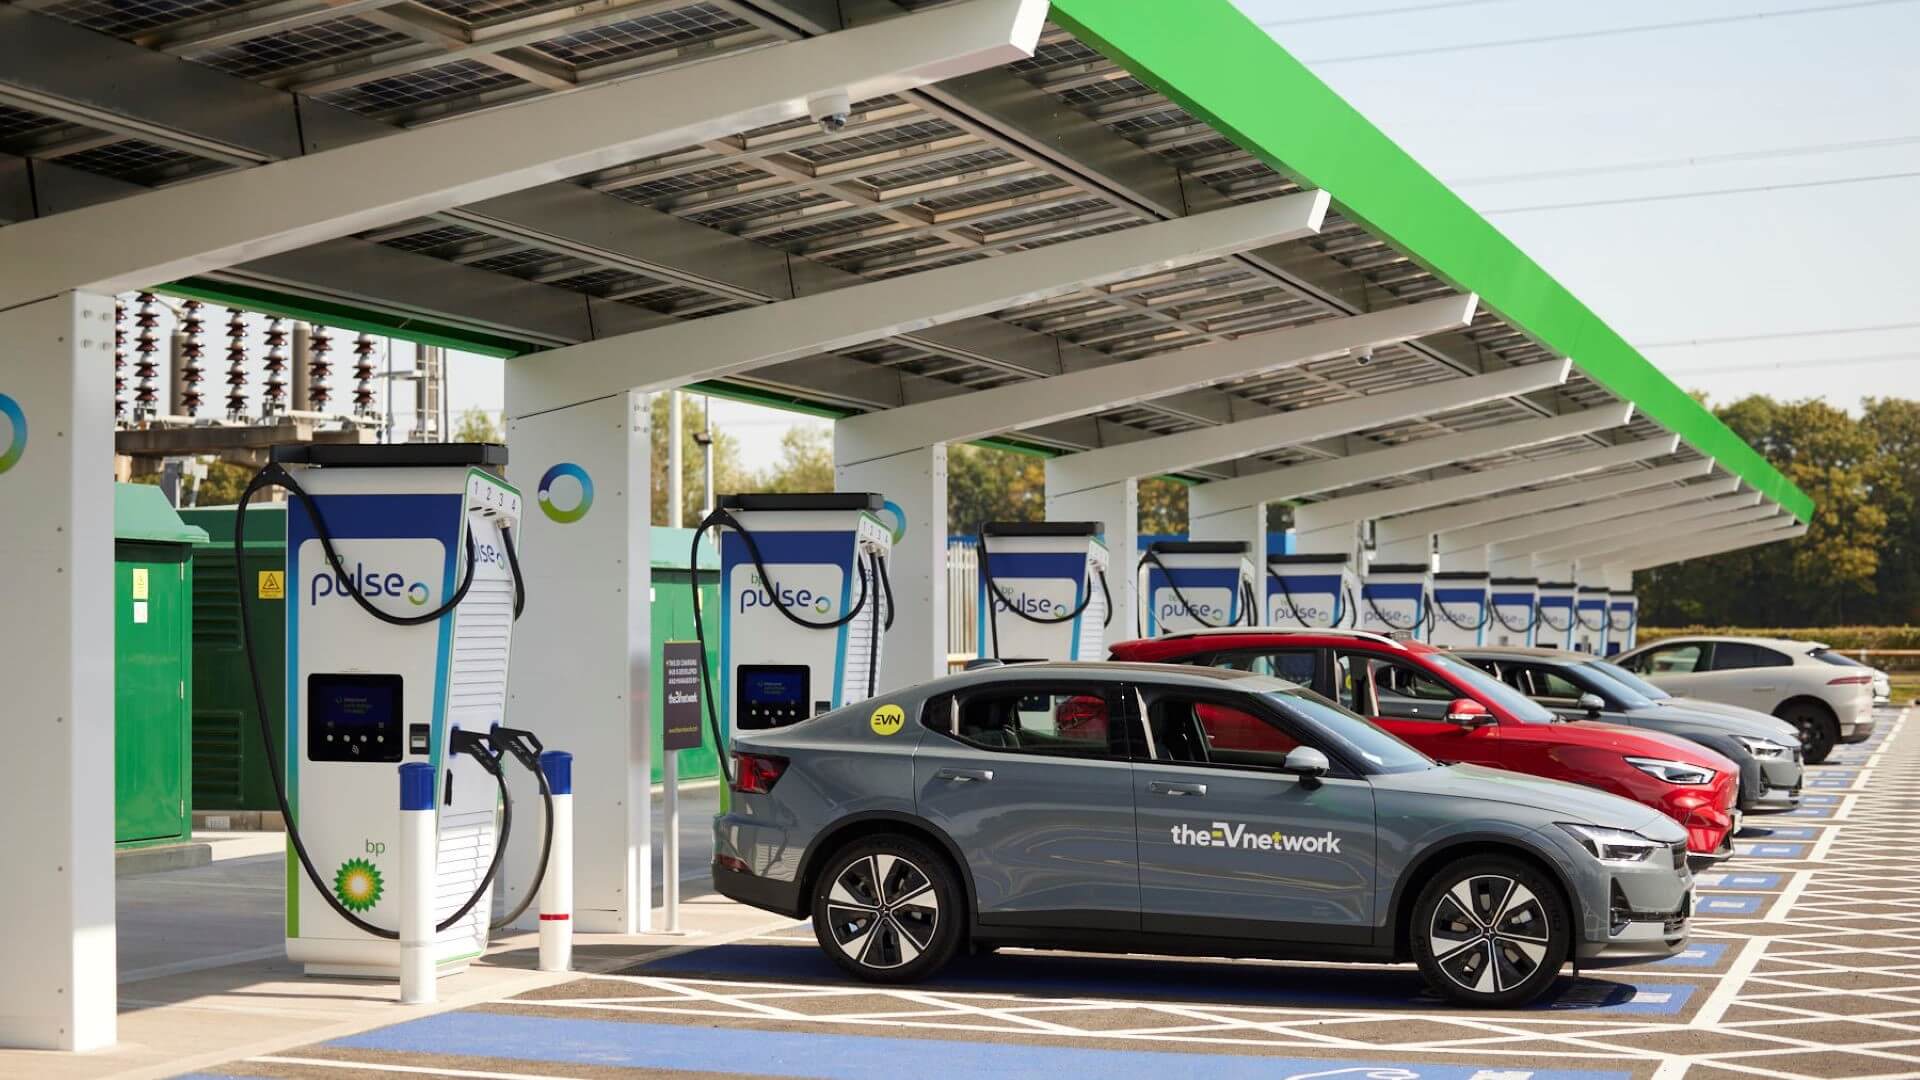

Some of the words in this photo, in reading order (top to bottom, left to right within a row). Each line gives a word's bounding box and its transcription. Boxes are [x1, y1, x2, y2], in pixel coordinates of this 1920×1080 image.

[486, 486, 492, 501] 2
[312, 562, 405, 606] pulse
[741, 581, 812, 614] pulse
[992, 591, 1051, 617] pulse
[1274, 603, 1317, 622] pulse
[873, 713, 901, 726] EVN
[366, 838, 386, 857] bp
[1170, 821, 1342, 854] theEVnetwork
